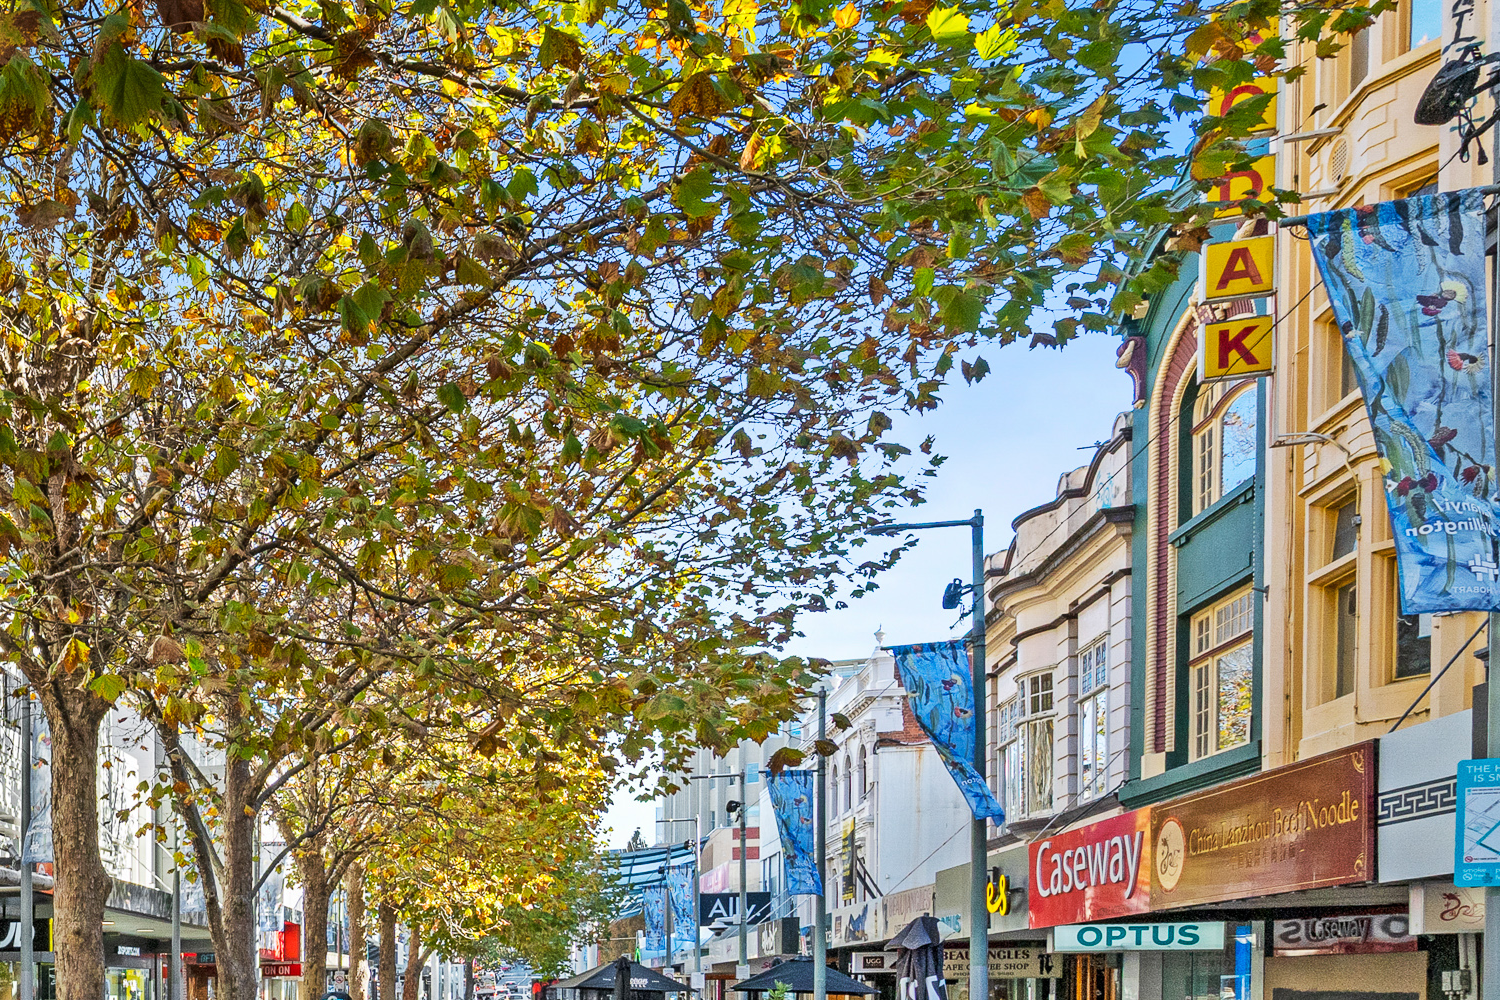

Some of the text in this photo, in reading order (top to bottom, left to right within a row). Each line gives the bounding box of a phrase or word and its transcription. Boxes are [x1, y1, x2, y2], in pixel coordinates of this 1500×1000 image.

[1466, 764, 1491, 773] THE
[1473, 774, 1484, 782] IS
[1188, 789, 1359, 856] China Lanzhou Beef Noodle
[1036, 831, 1145, 899] Caseway
[986, 874, 1008, 916] es
[1077, 925, 1200, 946] OPTUS
[278, 966, 290, 974] ON
